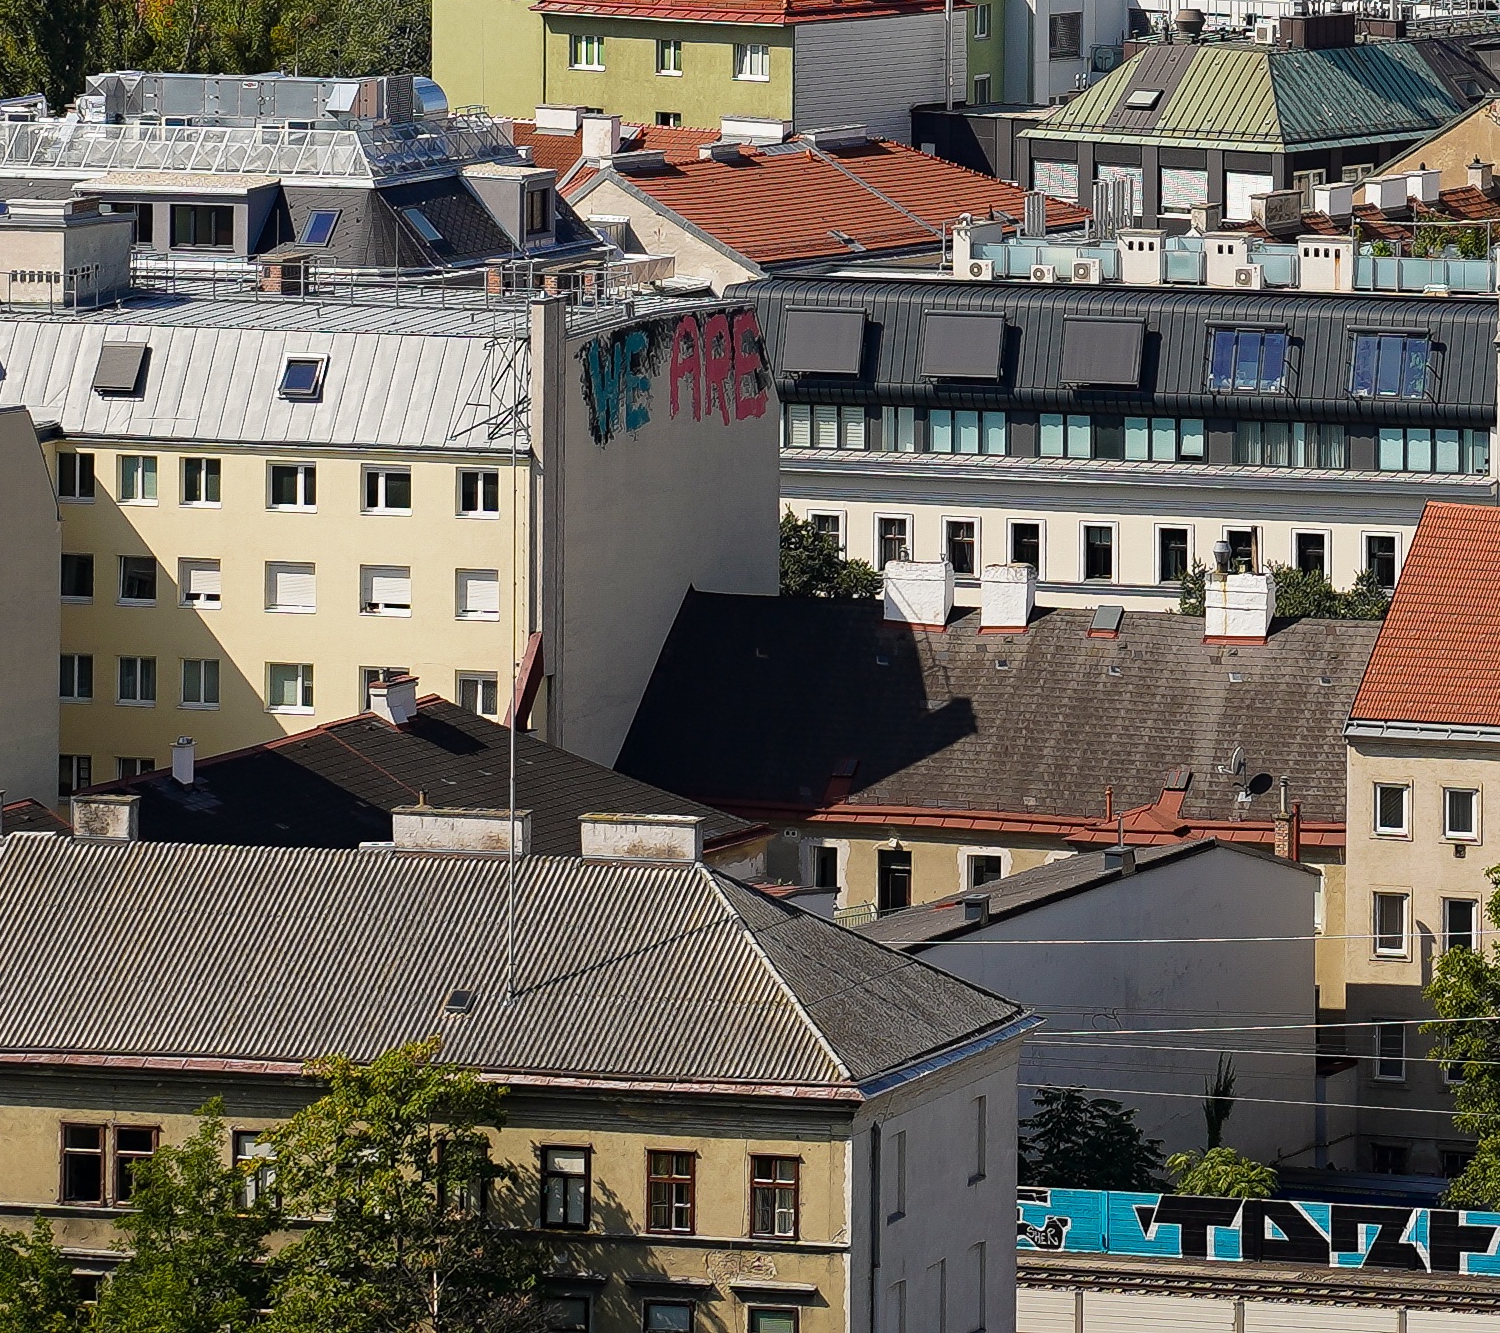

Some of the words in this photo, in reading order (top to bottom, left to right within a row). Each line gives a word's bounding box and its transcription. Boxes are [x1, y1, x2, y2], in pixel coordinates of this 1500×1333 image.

[587, 331, 652, 438] WE
[670, 311, 769, 426] ARE
[1026, 1226, 1059, 1246] SHER
